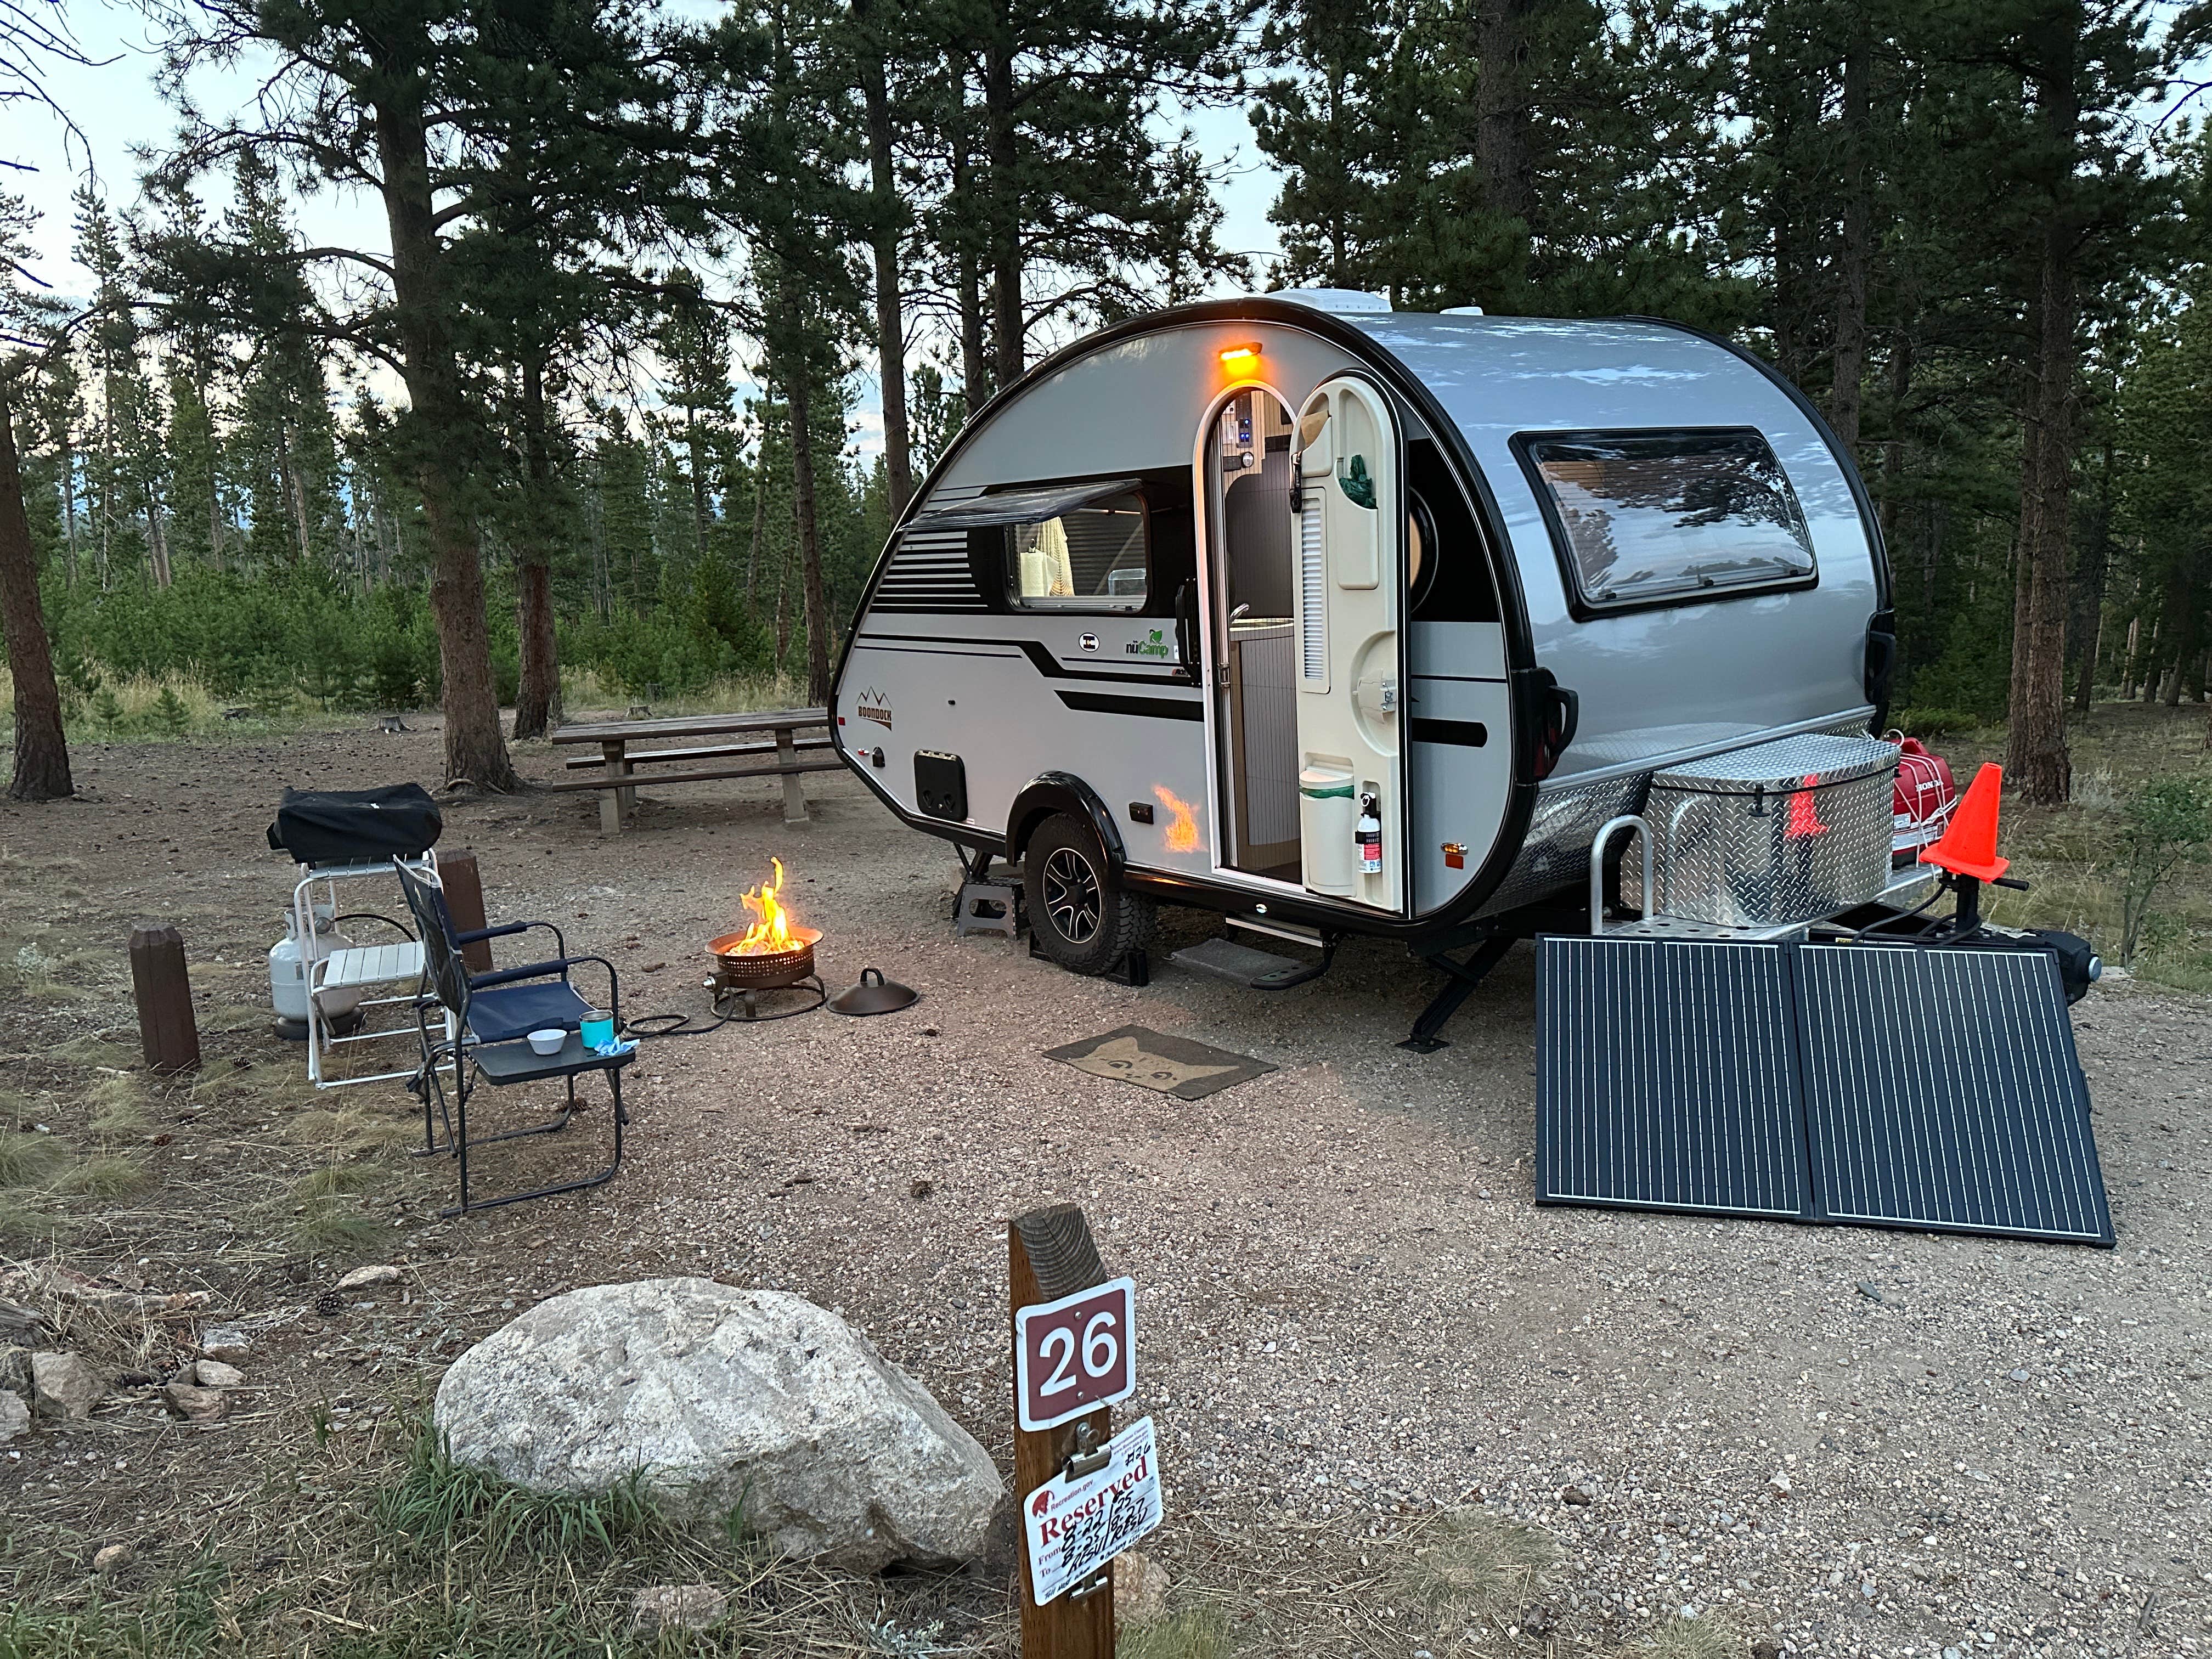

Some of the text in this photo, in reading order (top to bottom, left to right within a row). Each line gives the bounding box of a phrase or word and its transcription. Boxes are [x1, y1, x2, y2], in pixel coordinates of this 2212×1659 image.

[1126, 640, 1169, 659] nüCamp
[858, 706, 892, 721] BOONDOCK
[1039, 1311, 1118, 1397] 26
[1039, 1454, 1149, 1549] Reserved
[1050, 1479, 1093, 1511] Recreation.gov
[1037, 1546, 1062, 1566] From
[1040, 1567, 1051, 1578] To
